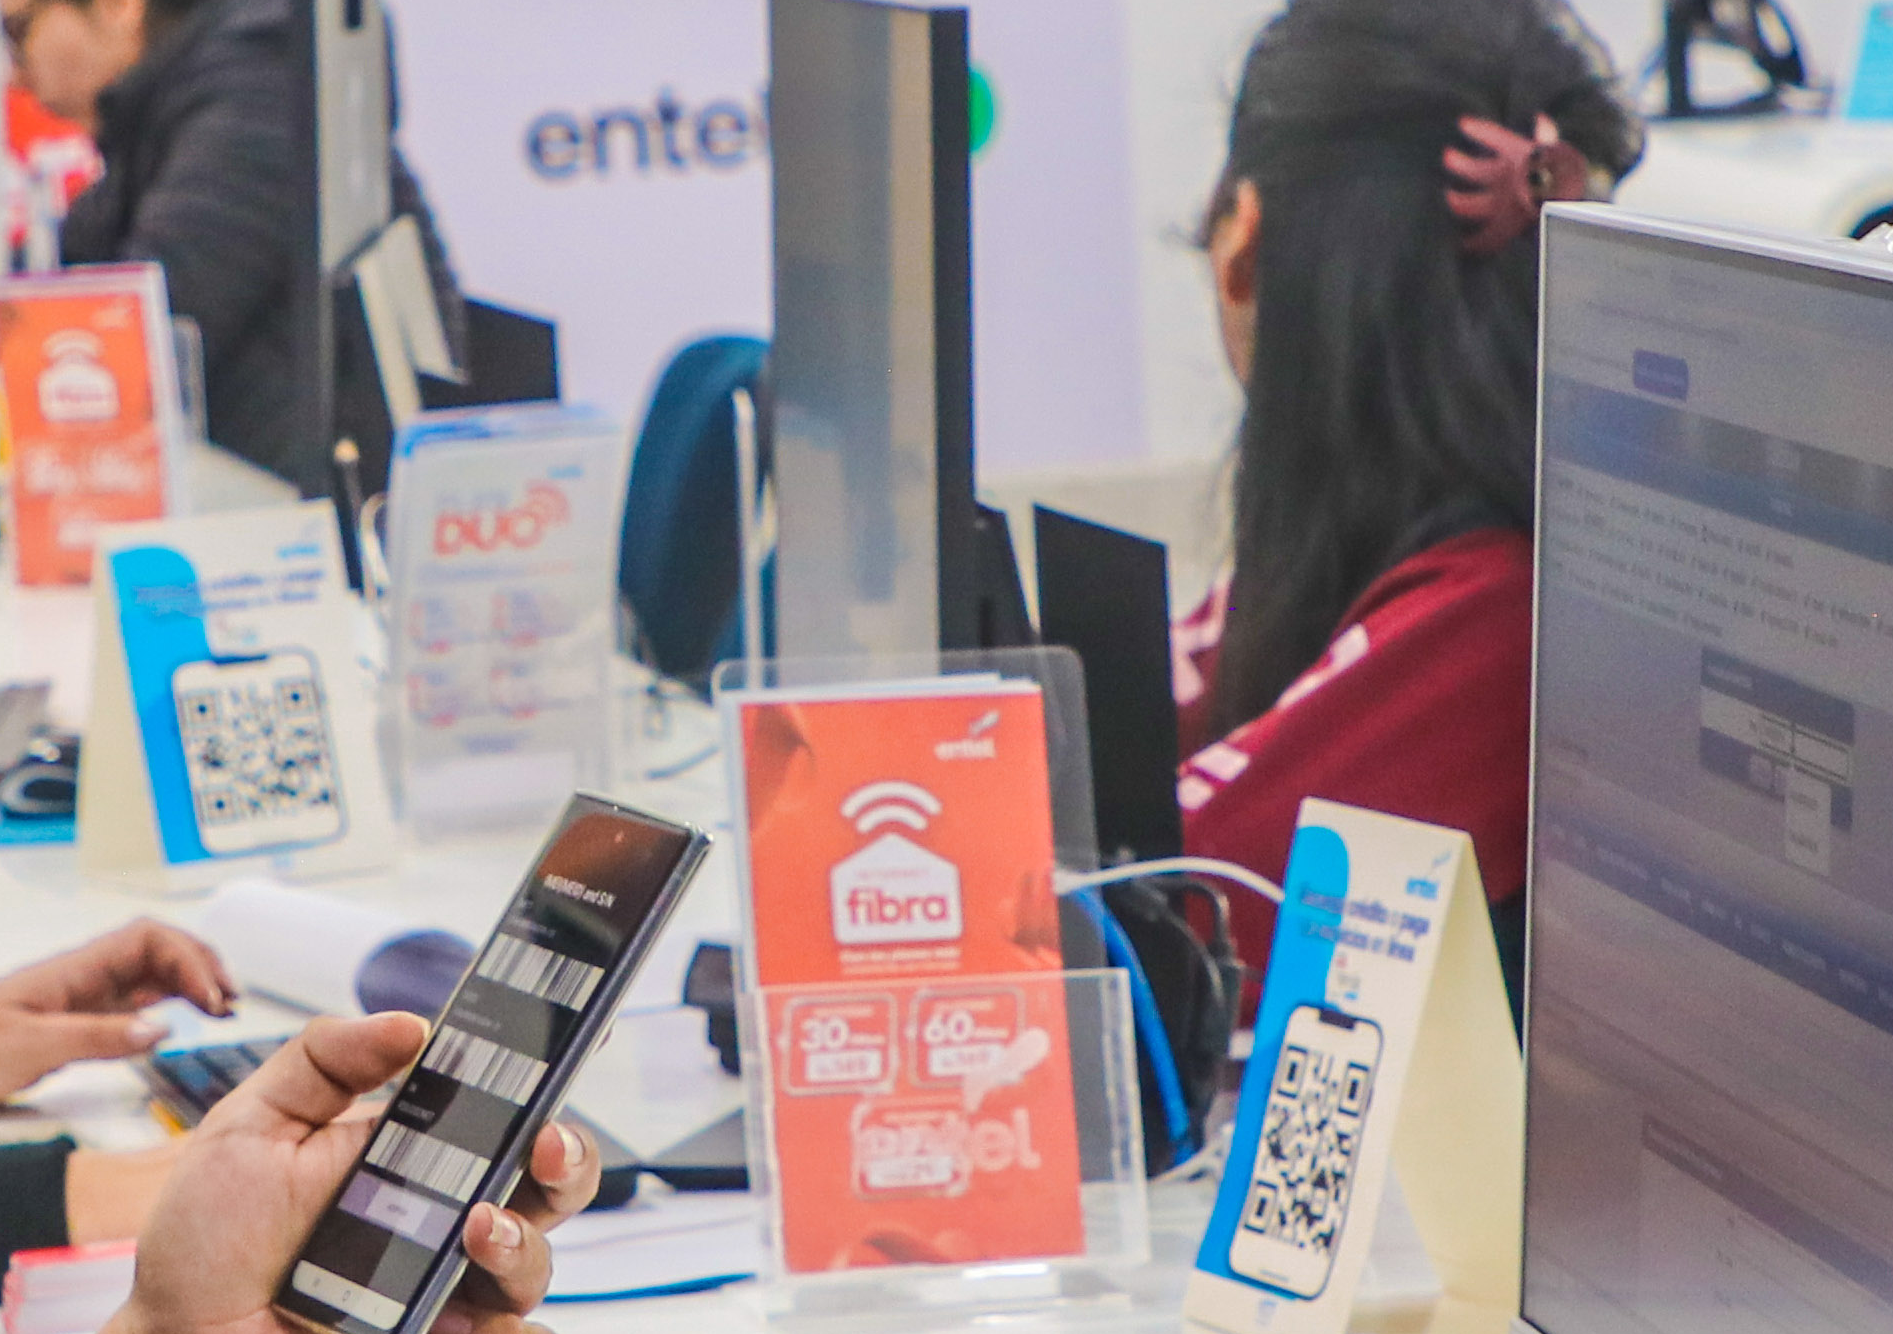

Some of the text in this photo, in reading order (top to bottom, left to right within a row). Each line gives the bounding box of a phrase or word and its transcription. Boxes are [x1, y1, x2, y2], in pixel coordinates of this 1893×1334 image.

[523, 85, 772, 178] ente
[433, 507, 546, 557] DUO
[847, 888, 950, 925] fibra
[800, 1017, 850, 1053] 30
[923, 1009, 975, 1044] 60
